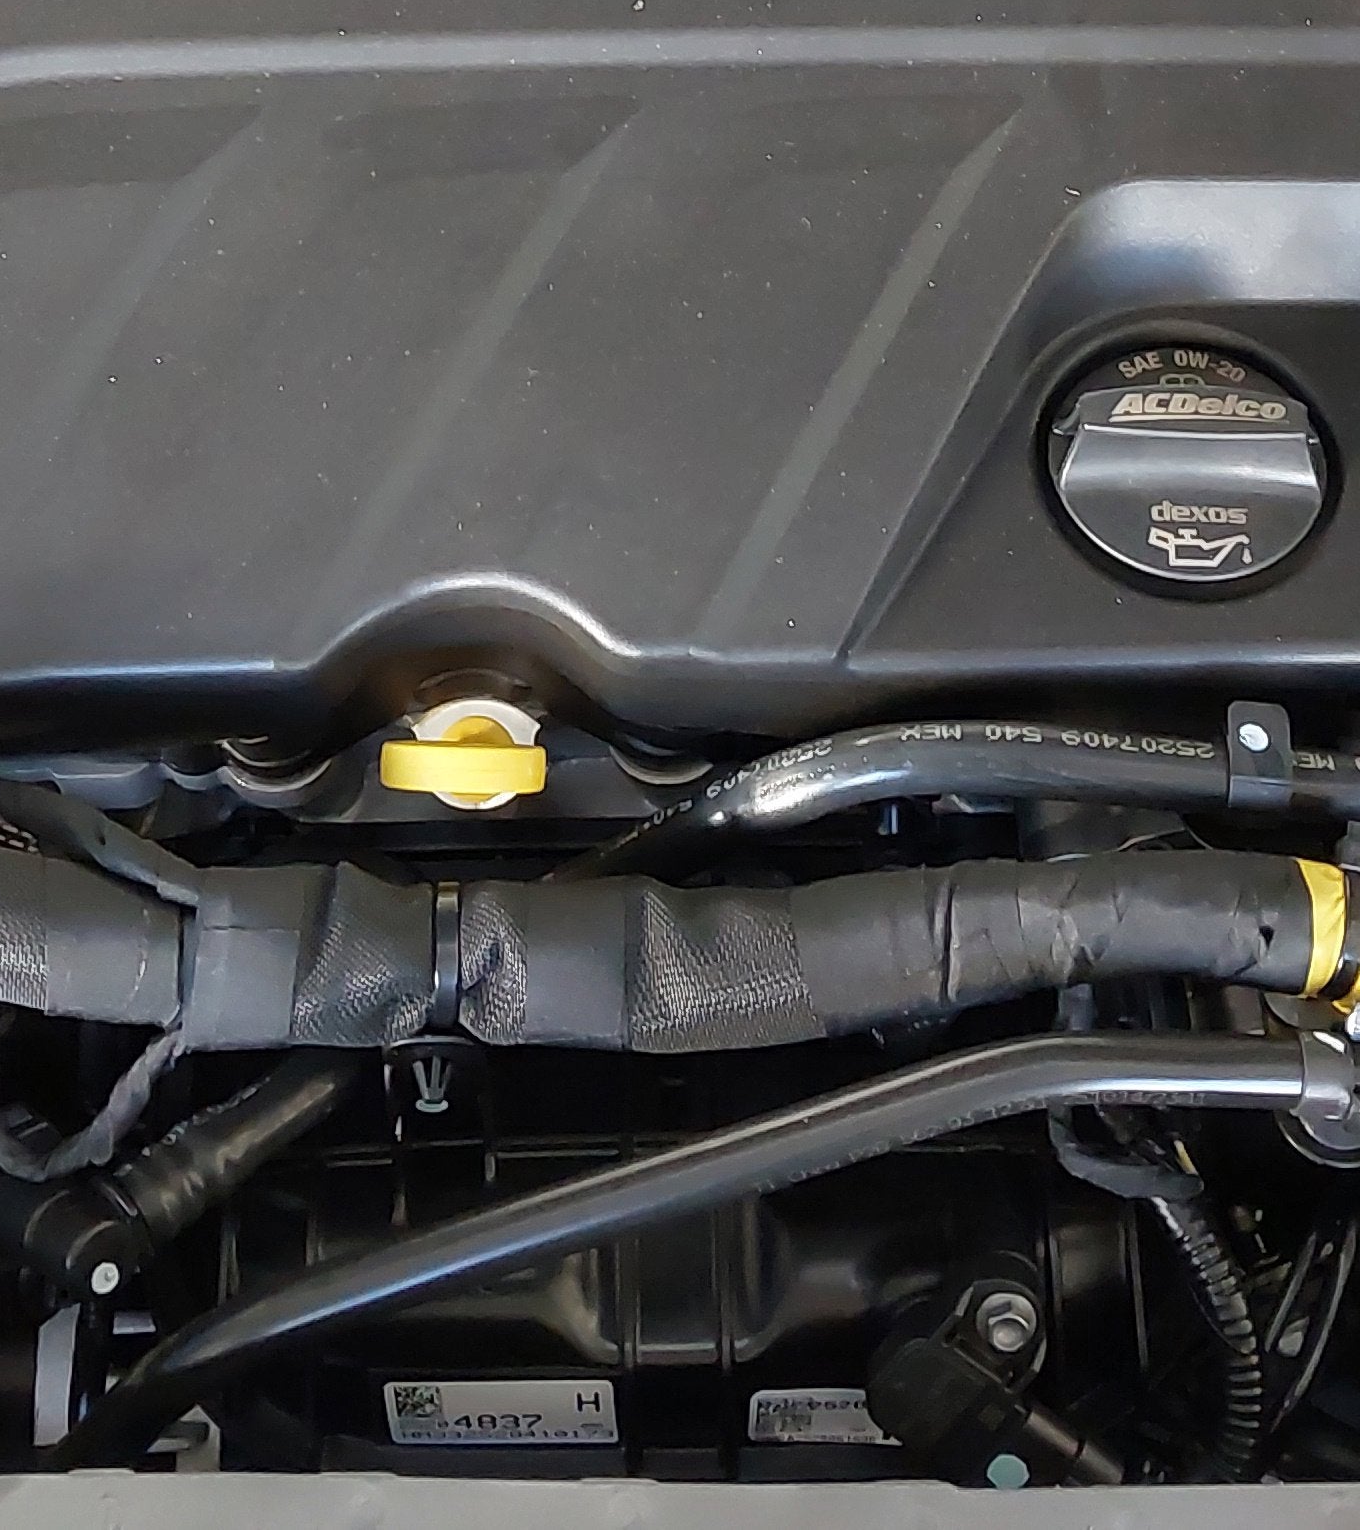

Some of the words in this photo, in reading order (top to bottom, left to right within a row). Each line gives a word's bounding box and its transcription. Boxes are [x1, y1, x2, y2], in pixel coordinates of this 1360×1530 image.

[1117, 350, 1165, 380] SAE
[1173, 349, 1248, 384] 0W-20
[1110, 392, 1288, 421] ACDelco
[1150, 500, 1249, 525] dexos
[898, 723, 962, 743] MEX
[983, 723, 1043, 744] 540
[1058, 730, 1217, 760] 25207409
[1290, 751, 1337, 771] ME
[576, 1391, 601, 1413] H
